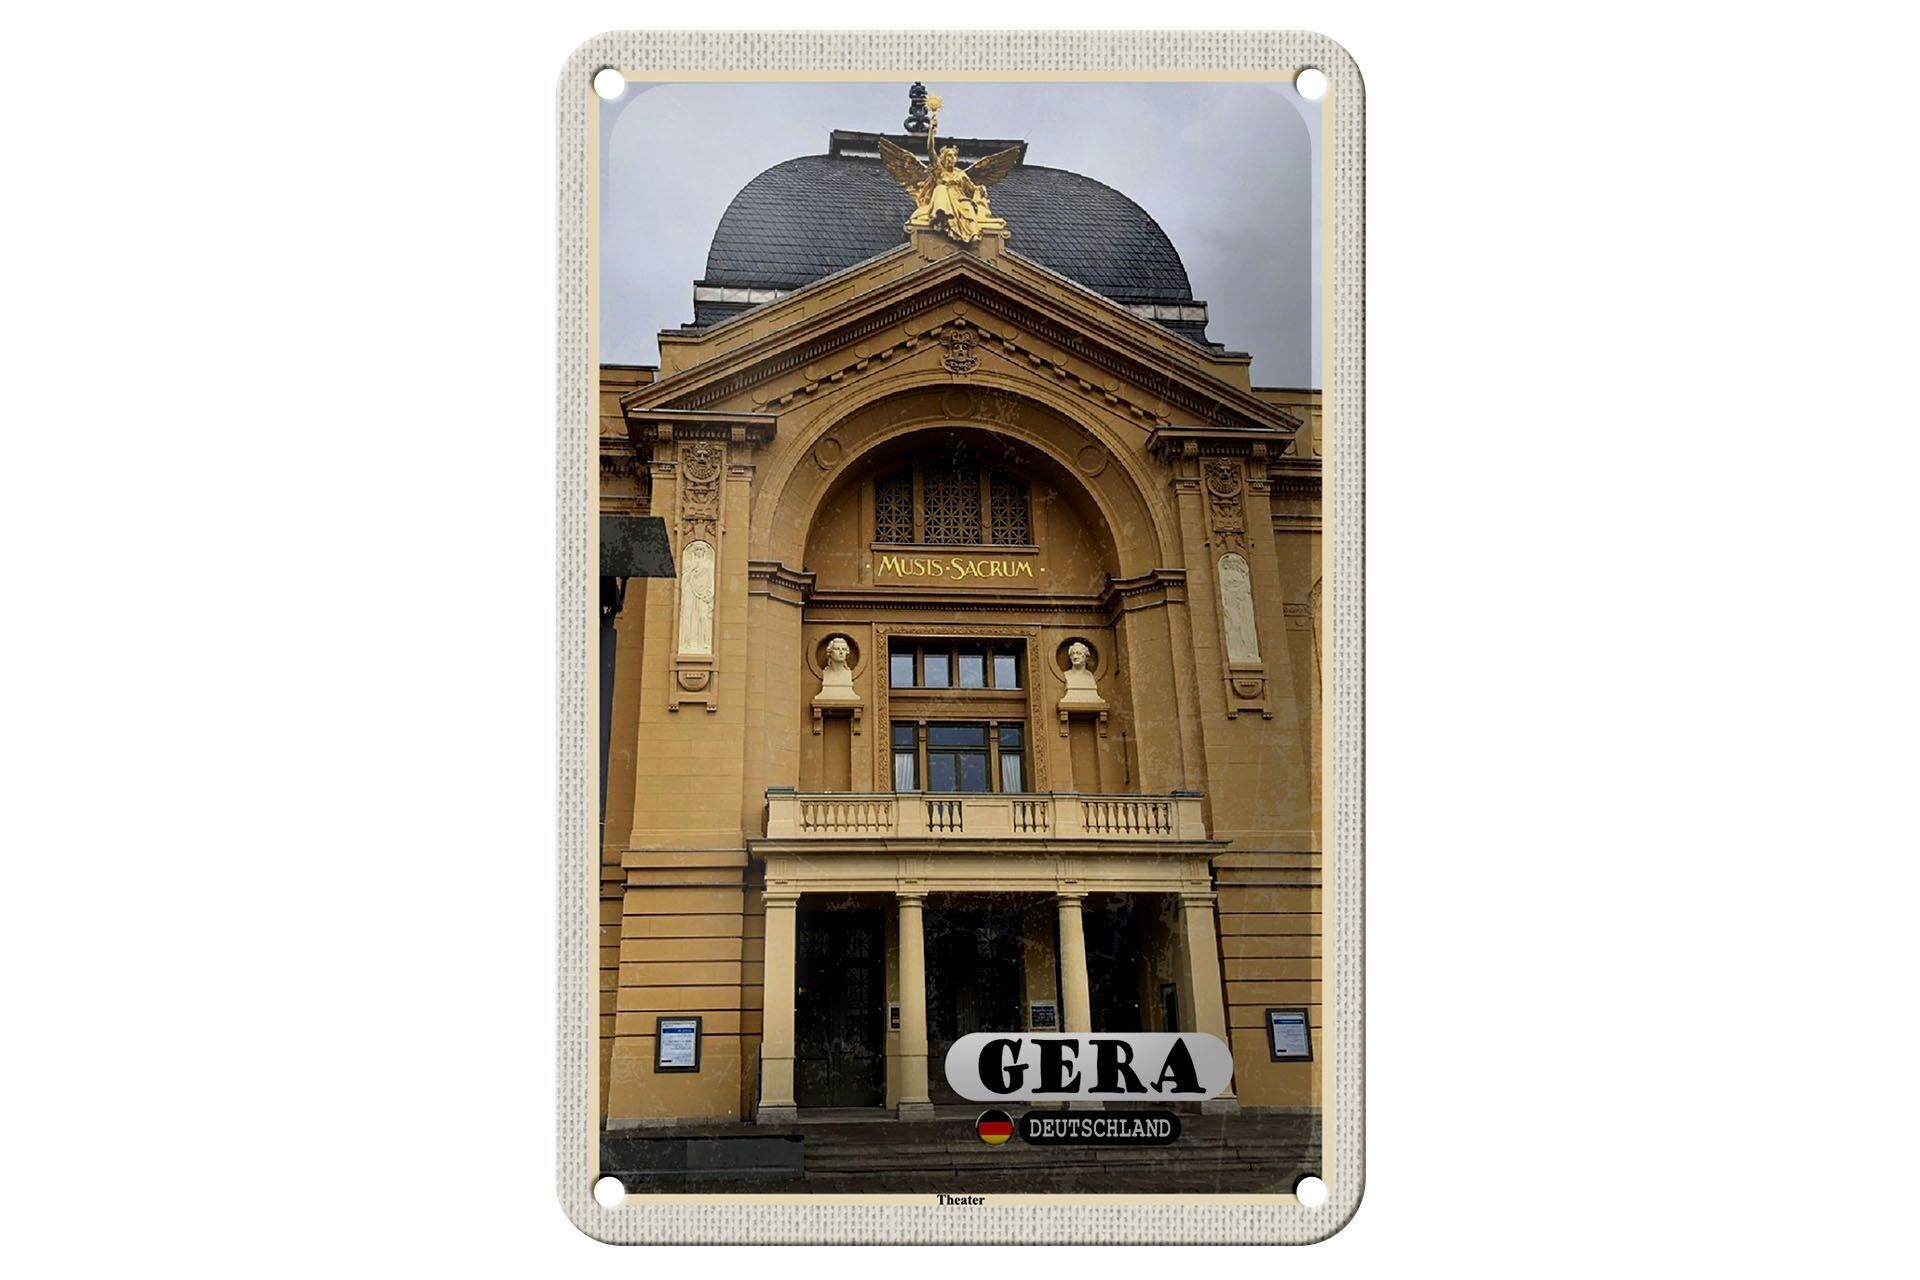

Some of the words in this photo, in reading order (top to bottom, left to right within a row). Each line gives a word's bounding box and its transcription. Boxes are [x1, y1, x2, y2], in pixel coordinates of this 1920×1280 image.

[878, 555, 943, 577] MUSIS
[950, 557, 1033, 580] SACRUM
[978, 1037, 1207, 1095] GERA
[1029, 1118, 1171, 1138] DEUTSCHLAND
[936, 1194, 985, 1206] Theater
